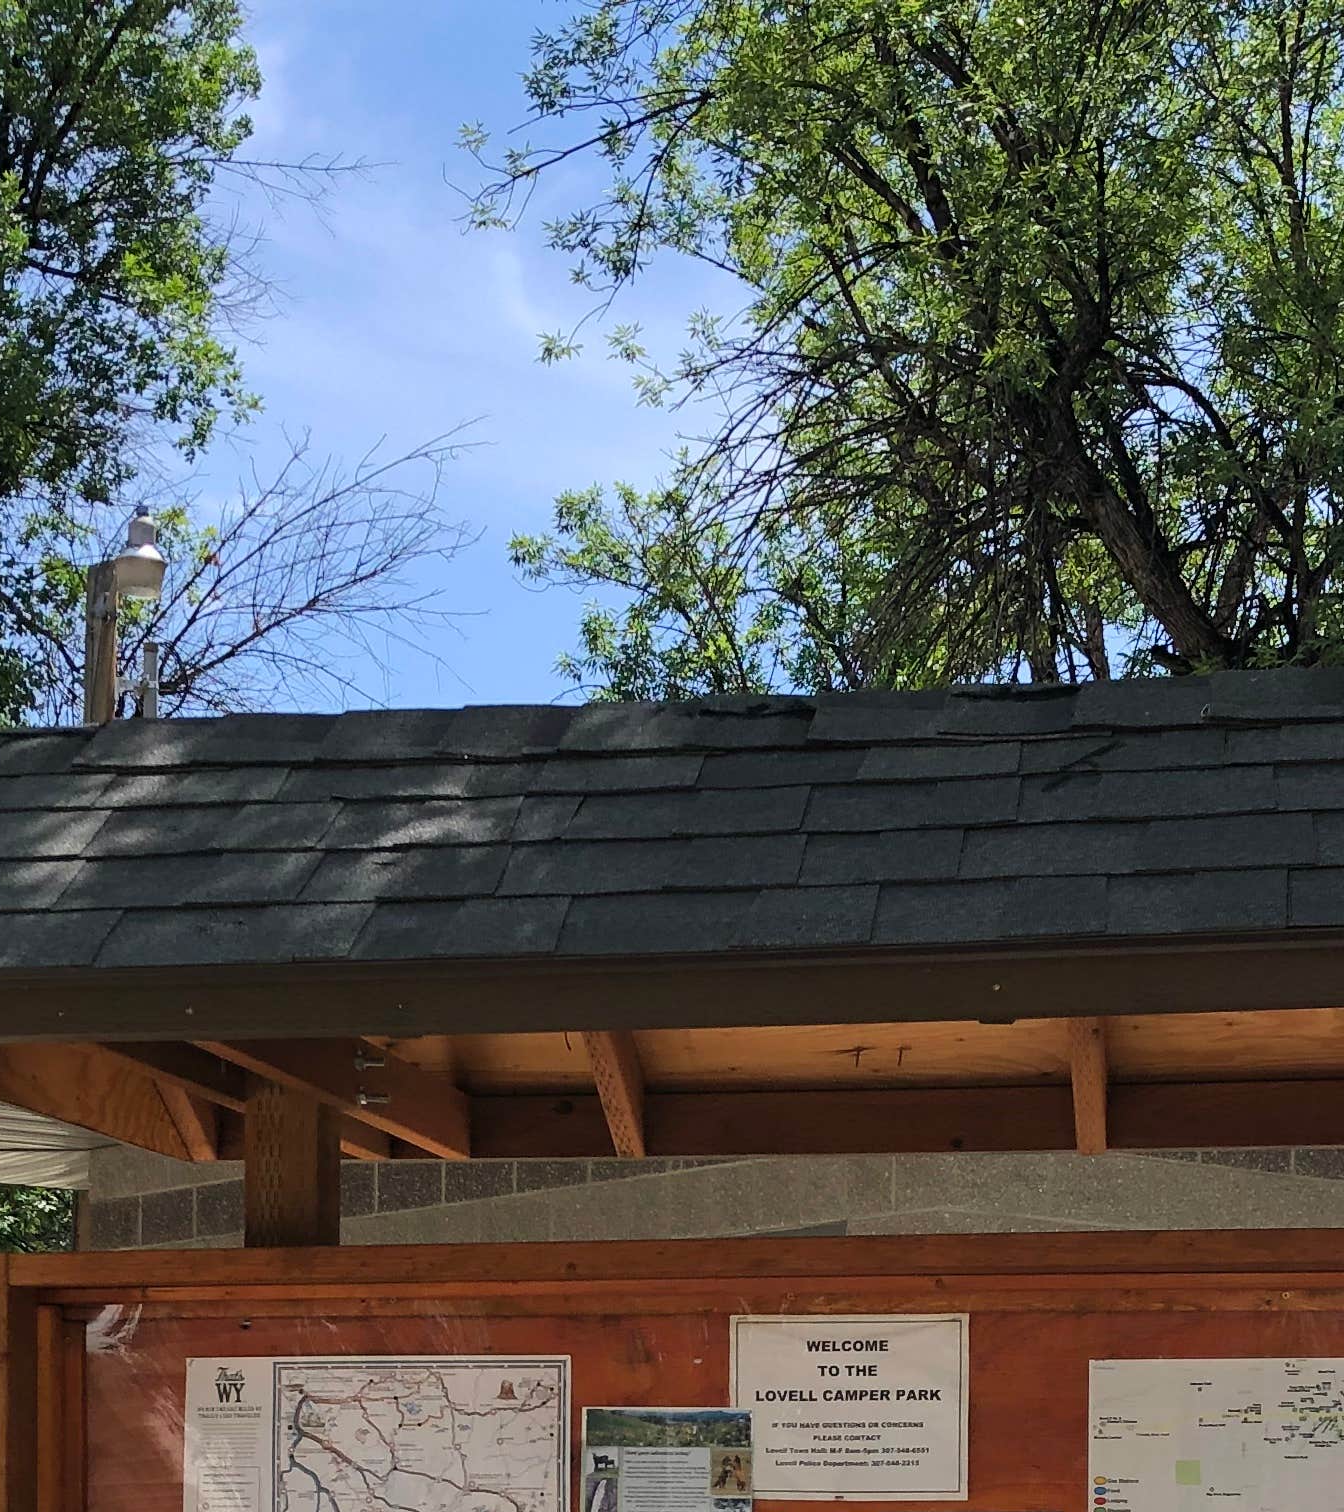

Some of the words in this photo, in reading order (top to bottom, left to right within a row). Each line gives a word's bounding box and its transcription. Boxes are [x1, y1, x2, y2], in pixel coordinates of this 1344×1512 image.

[806, 1339, 889, 1352] WELCOME
[817, 1365, 840, 1376] TO
[845, 1365, 878, 1376] THE
[215, 1383, 245, 1403] WY
[755, 1390, 818, 1402] LOVELL
[822, 1389, 891, 1401] CAMPER
[895, 1389, 942, 1401] PARK
